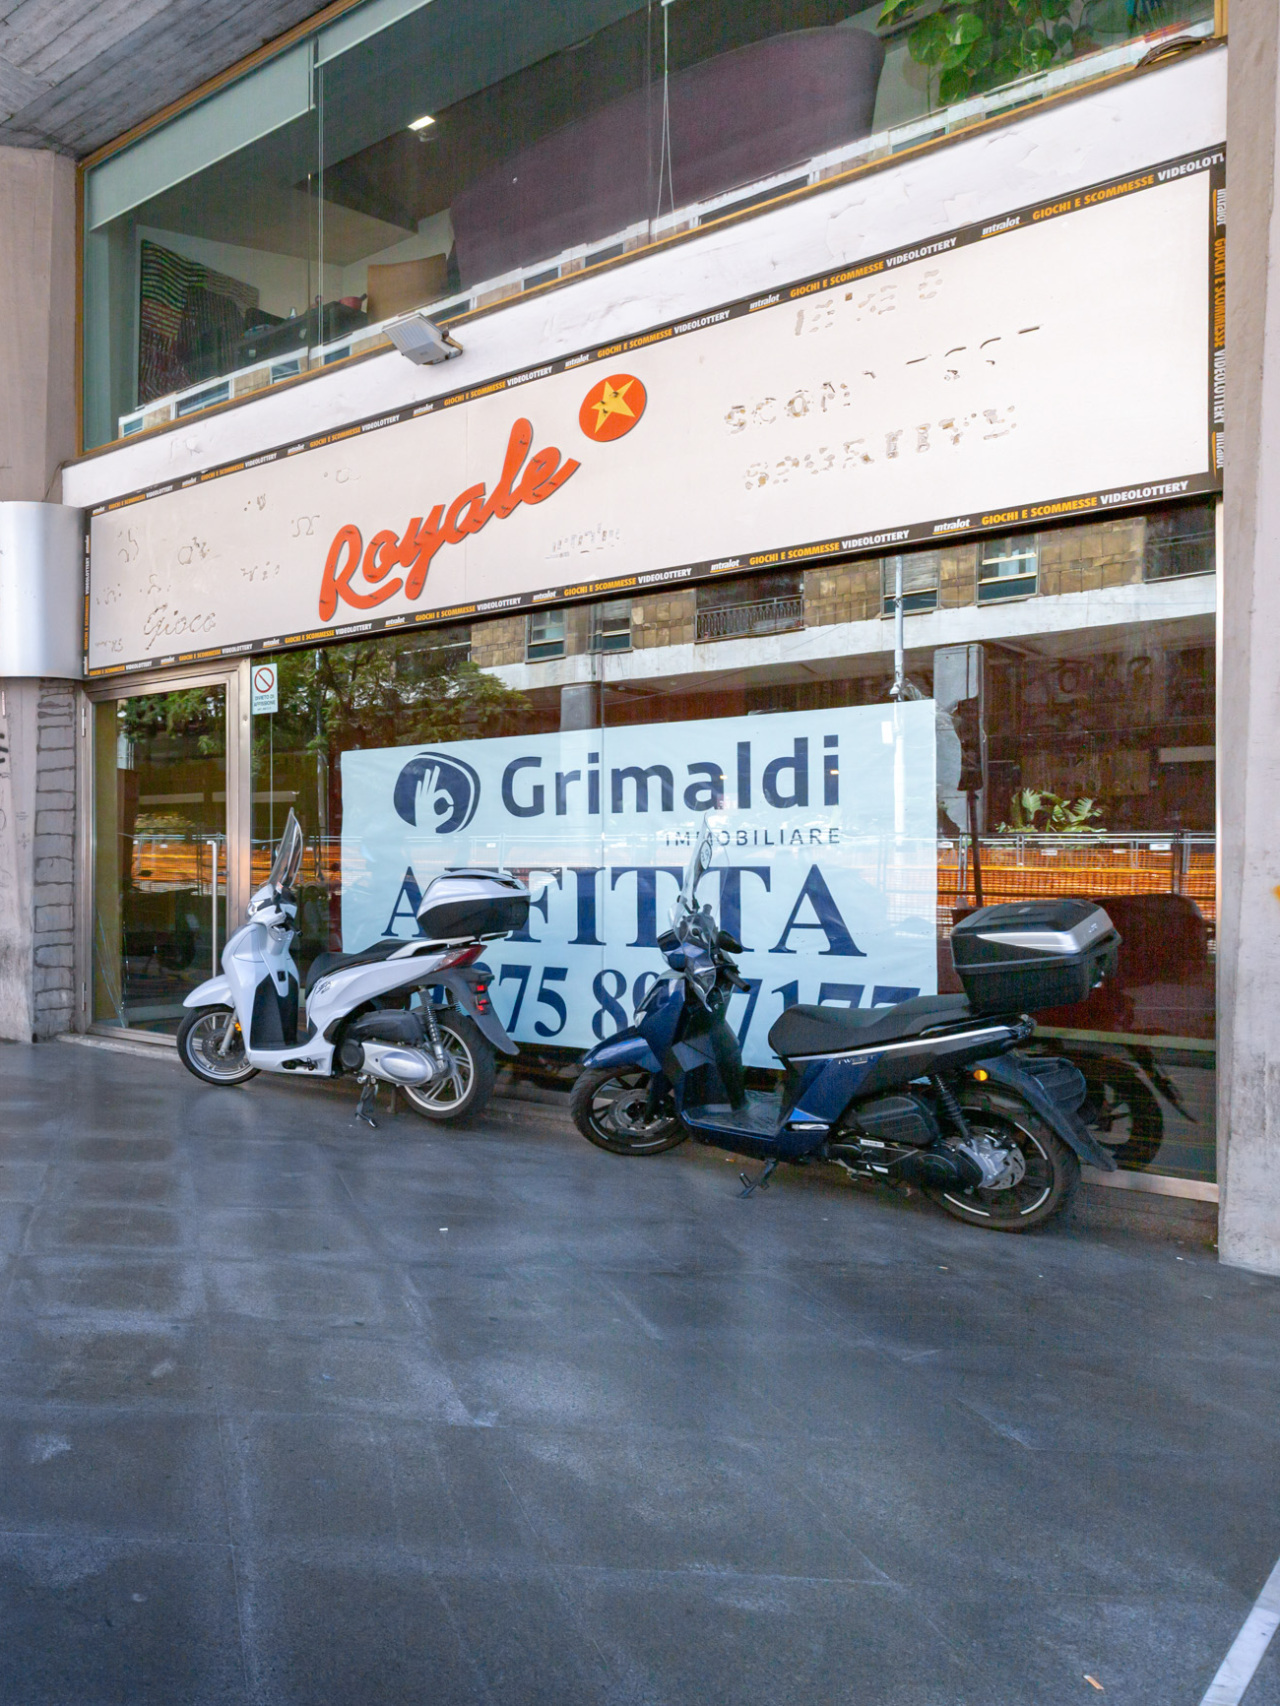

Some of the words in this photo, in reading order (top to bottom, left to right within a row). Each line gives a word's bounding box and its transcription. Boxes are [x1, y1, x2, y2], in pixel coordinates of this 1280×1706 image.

[982, 216, 1020, 236] intralot
[1032, 201, 1071, 221] GIOCHI
[1074, 198, 1081, 208] E
[1084, 174, 1155, 205] SCOMMESSE
[749, 293, 780, 310] intralot
[790, 282, 820, 298] GIOCHI
[822, 279, 828, 289] E
[829, 261, 885, 286] SCOMMESSE
[886, 237, 957, 268] VIDEOLOTTERY
[597, 345, 622, 358] GIOCHI
[623, 342, 628, 351] E
[629, 329, 673, 349] SCOMMESSE
[674, 310, 730, 335] VIDEOLOTTERY
[444, 394, 465, 406] GIOCHI
[470, 381, 506, 399] SCOMMESSE
[507, 366, 553, 386] VIDEOLOTTERY
[361, 415, 400, 432] VIDEOLOTTERY
[319, 417, 581, 623] Royale
[933, 517, 971, 533] intralot
[981, 509, 1019, 526] GIOCHI
[1021, 507, 1028, 519] E
[1030, 495, 1098, 518] SCOMMESSE
[1099, 479, 1189, 506] VIDEOLOTTERY
[710, 558, 740, 572] intralot
[749, 552, 779, 566] GIOCHI
[780, 551, 786, 561] E
[787, 540, 840, 560] SCOMMESSE
[841, 528, 910, 550] VIDEOLOTTERY
[564, 585, 588, 597] GIOCHI
[588, 584, 594, 592] E
[594, 577, 637, 592] SCOMMESSE
[637, 567, 693, 585] VIDEOLOTTERY
[335, 623, 373, 636] VIDEOLOTTERY
[415, 611, 436, 622] GIOCHI
[440, 604, 476, 619] SCOMMESSE
[476, 597, 522, 612] VIDEOLOTTERY
[501, 733, 841, 818] Grimaldi
[380, 866, 868, 957] AFITTA
